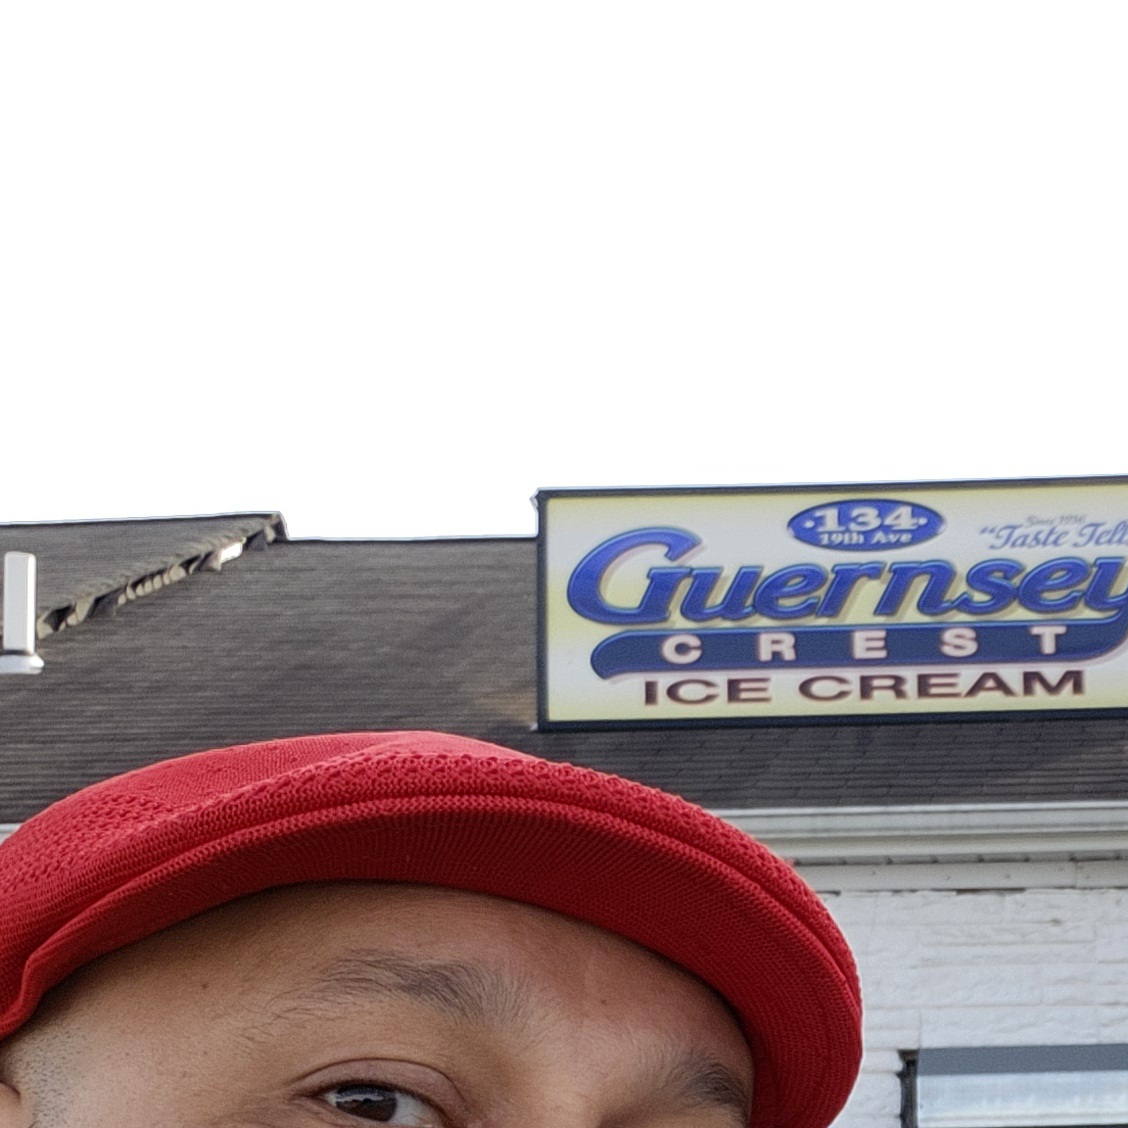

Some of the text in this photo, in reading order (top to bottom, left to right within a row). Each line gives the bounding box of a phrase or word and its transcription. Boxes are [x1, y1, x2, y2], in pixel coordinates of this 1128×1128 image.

[820, 531, 913, 546] 19th Ave
[659, 625, 1067, 666] CREST
[644, 669, 1085, 706] ICE CREAM
